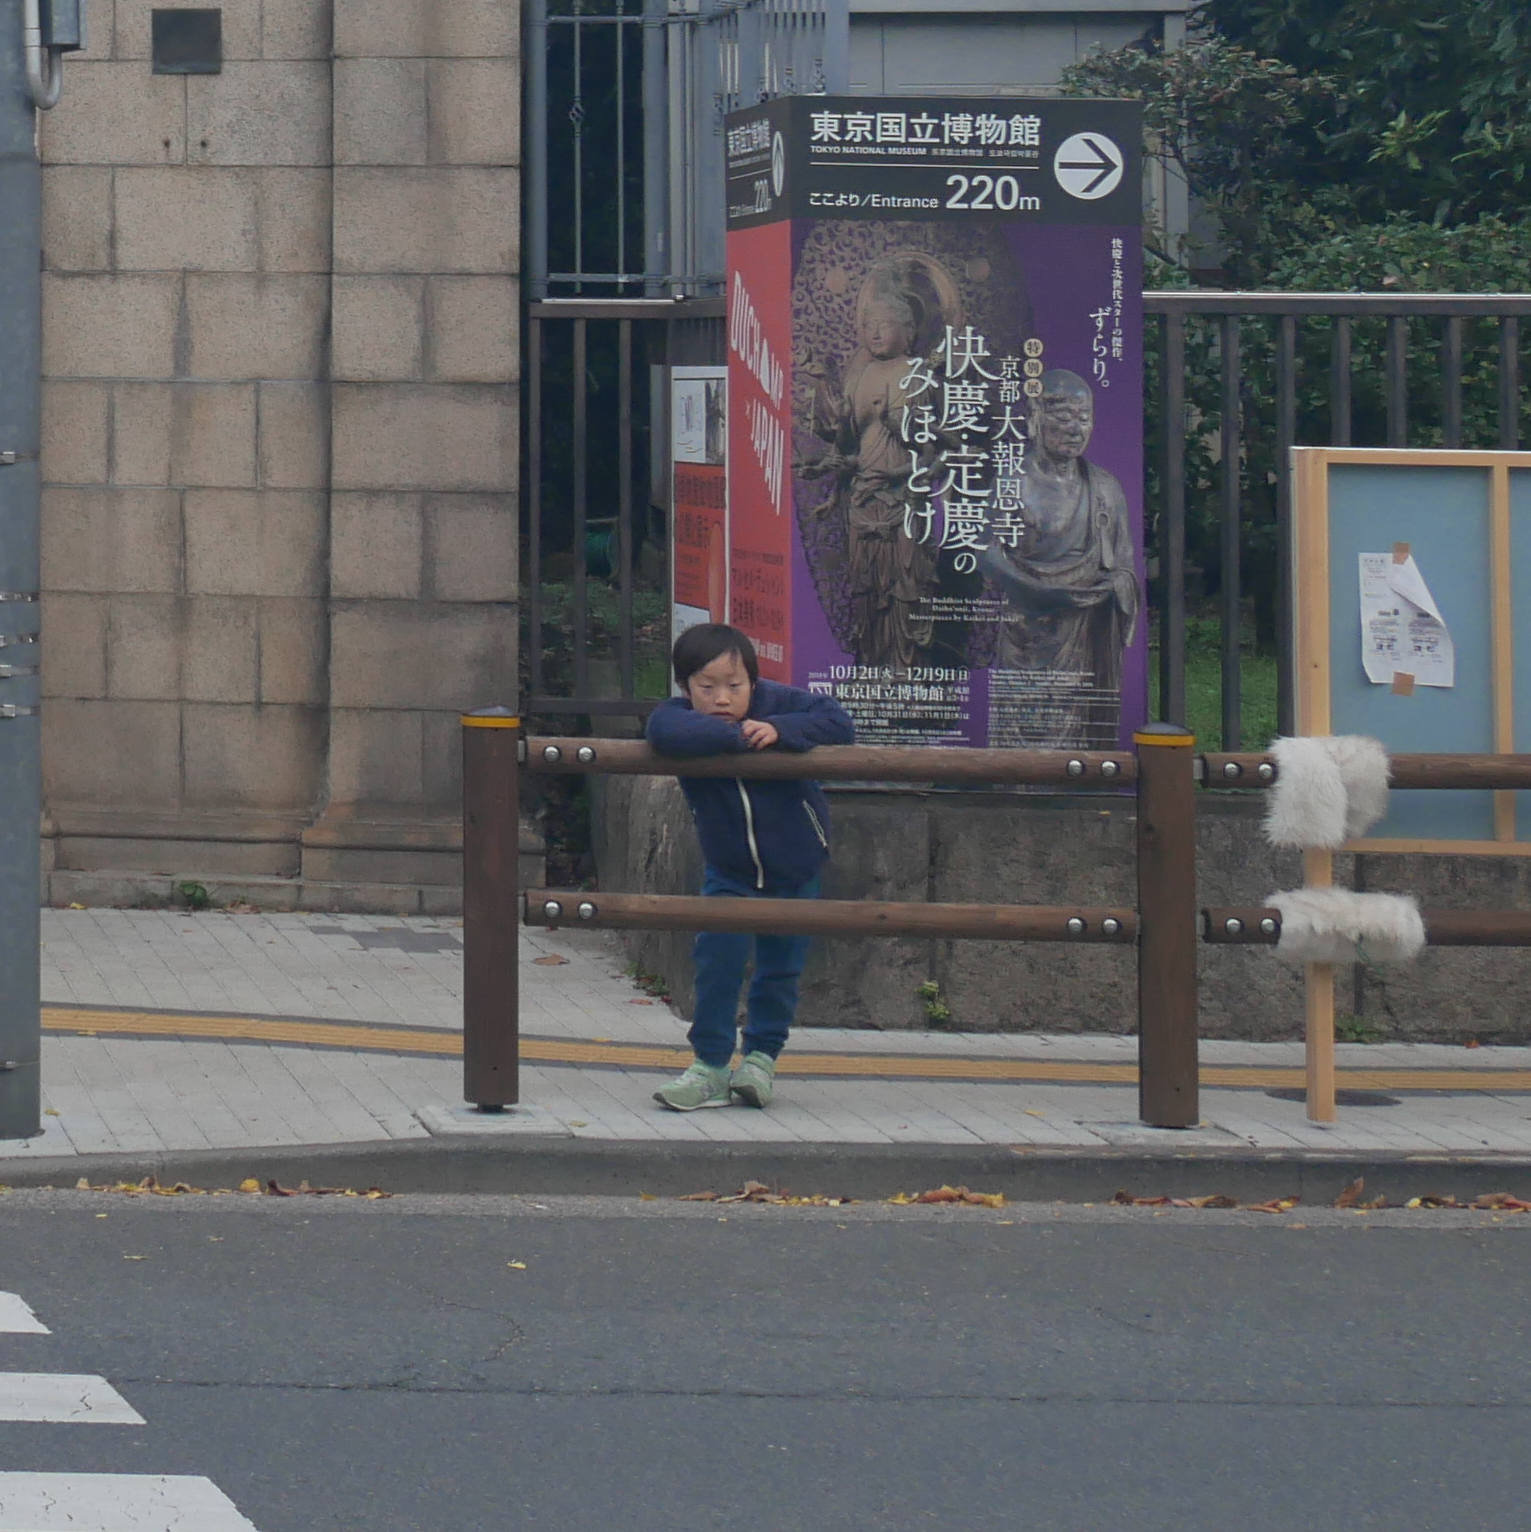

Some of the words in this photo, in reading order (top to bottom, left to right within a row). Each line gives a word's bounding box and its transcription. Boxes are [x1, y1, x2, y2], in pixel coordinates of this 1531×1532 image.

[810, 110, 1041, 147] 東京国立博物館
[810, 145, 841, 154] TOKYO
[842, 146, 887, 155] NATIONAL
[888, 147, 927, 156] MUSEUM
[945, 174, 1041, 211] 220m
[1024, 339, 1043, 397] 特別展
[1088, 306, 1112, 388] ずらり。
[750, 397, 784, 516] JAPAN
[898, 356, 940, 546] みほとけ
[928, 325, 1000, 575] 快慶・定慶の
[835, 683, 944, 701] 東京国立博物館
